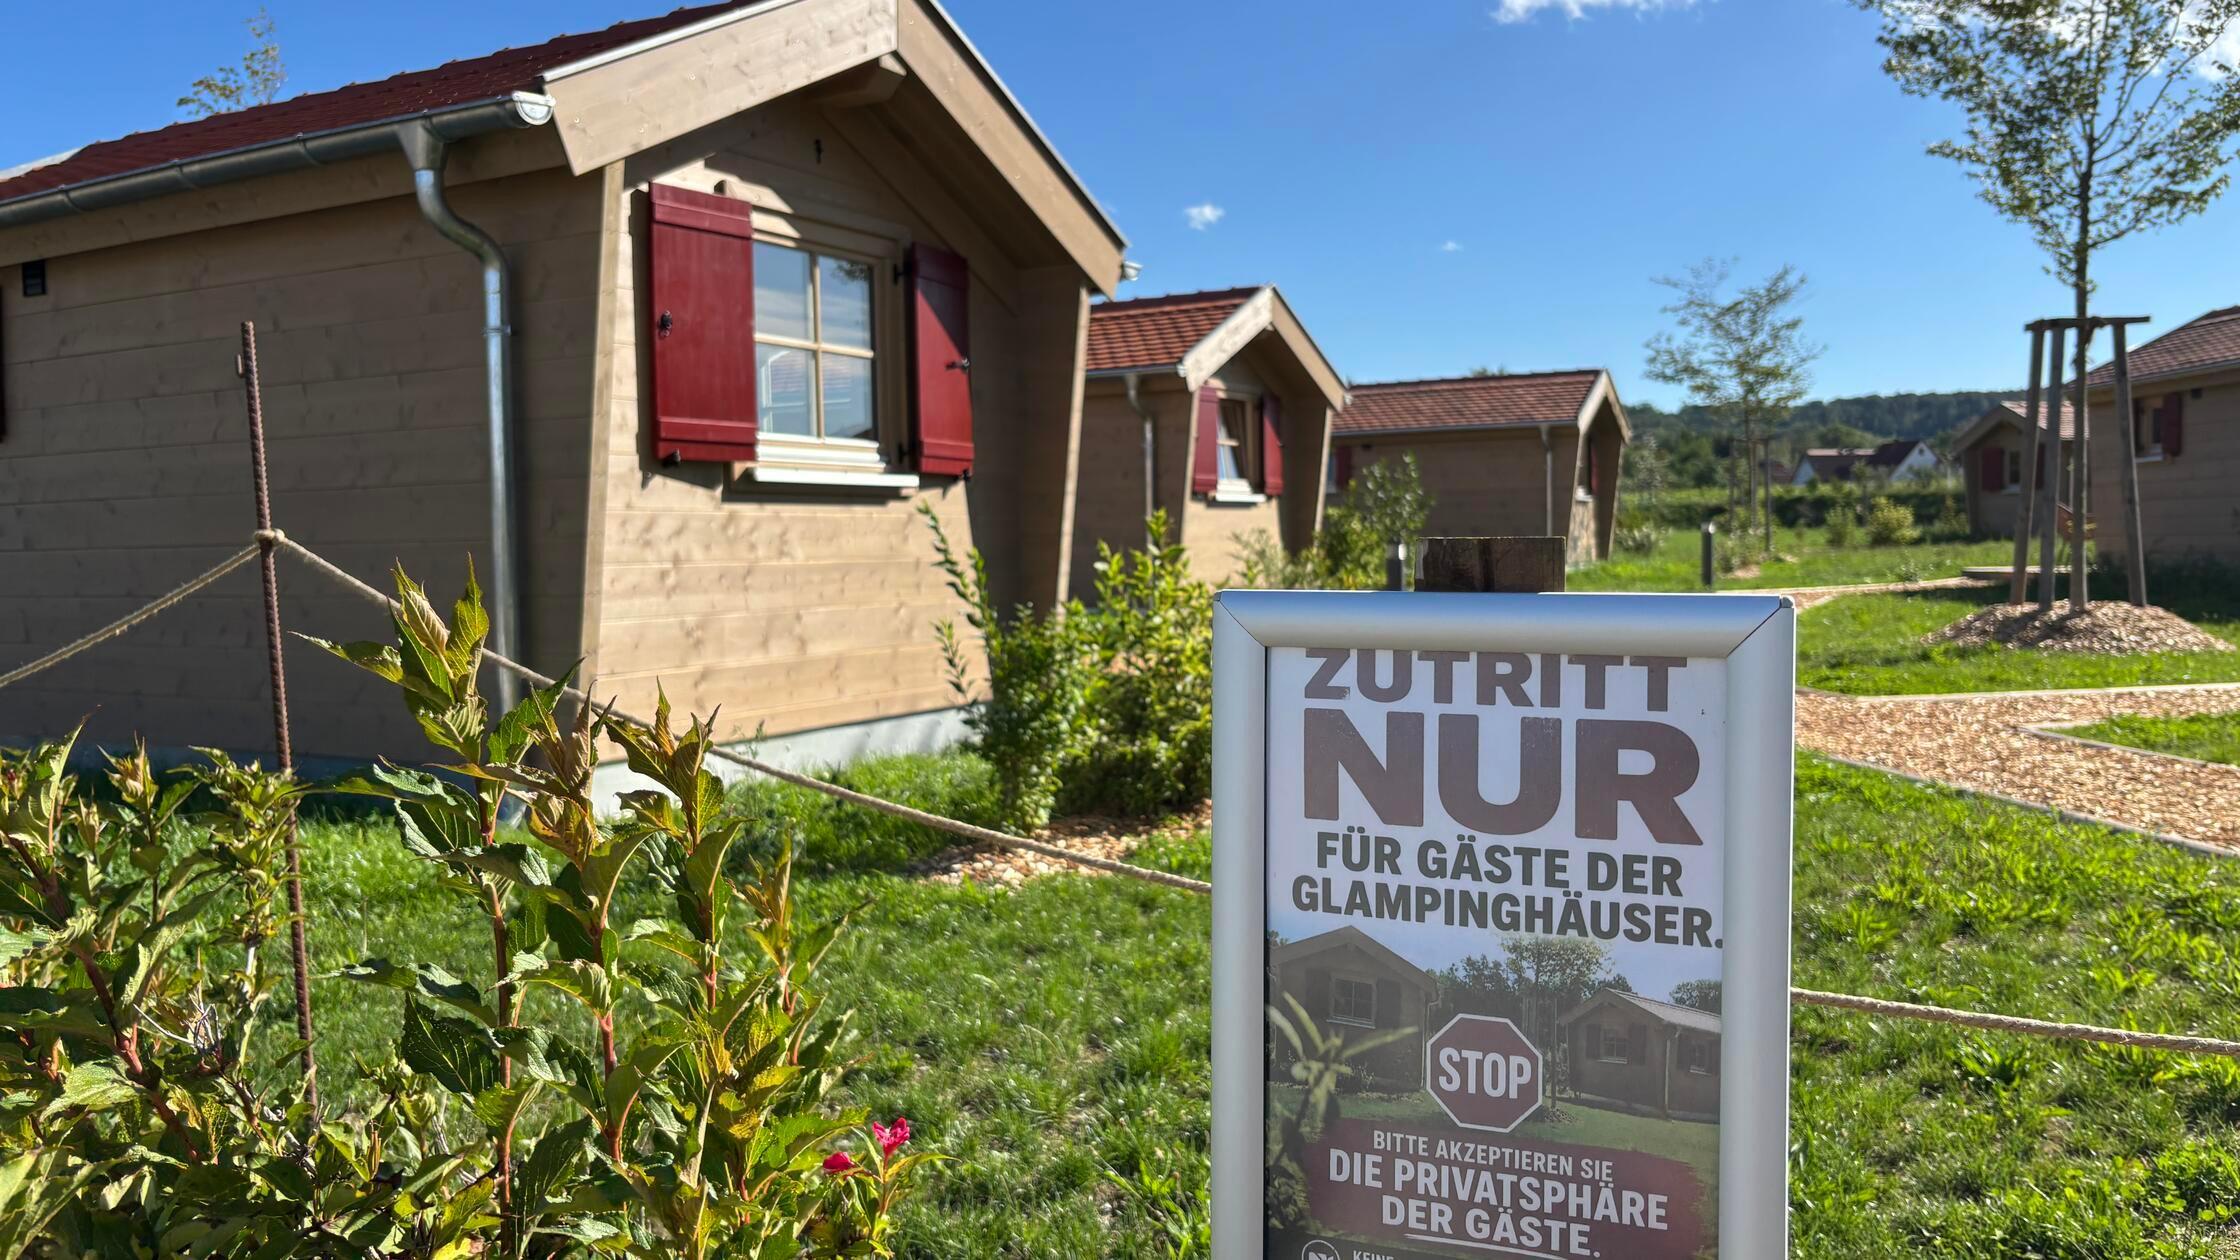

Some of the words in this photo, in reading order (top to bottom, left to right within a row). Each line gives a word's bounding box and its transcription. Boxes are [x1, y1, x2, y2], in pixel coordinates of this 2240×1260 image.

[1304, 647, 1687, 711] ZUTRITT
[1304, 707, 1703, 846] NUR
[1317, 826, 1401, 875] FÜR
[1417, 834, 1569, 889] GÄSTE
[1587, 851, 1683, 897] DER
[1292, 875, 1723, 949] GLAMPINGHÄUSER.
[1438, 1047, 1532, 1099] STOP
[1329, 1148, 1382, 1188] DIE
[1394, 1158, 1668, 1230] PRIVATSPHÄRE
[1373, 1129, 1428, 1156] BITTE
[1435, 1139, 1573, 1176] AKZEPTIEREN
[1580, 1157, 1613, 1182] SIE
[1382, 1194, 1453, 1235] DER
[1465, 1205, 1600, 1258] GÄSTE.
